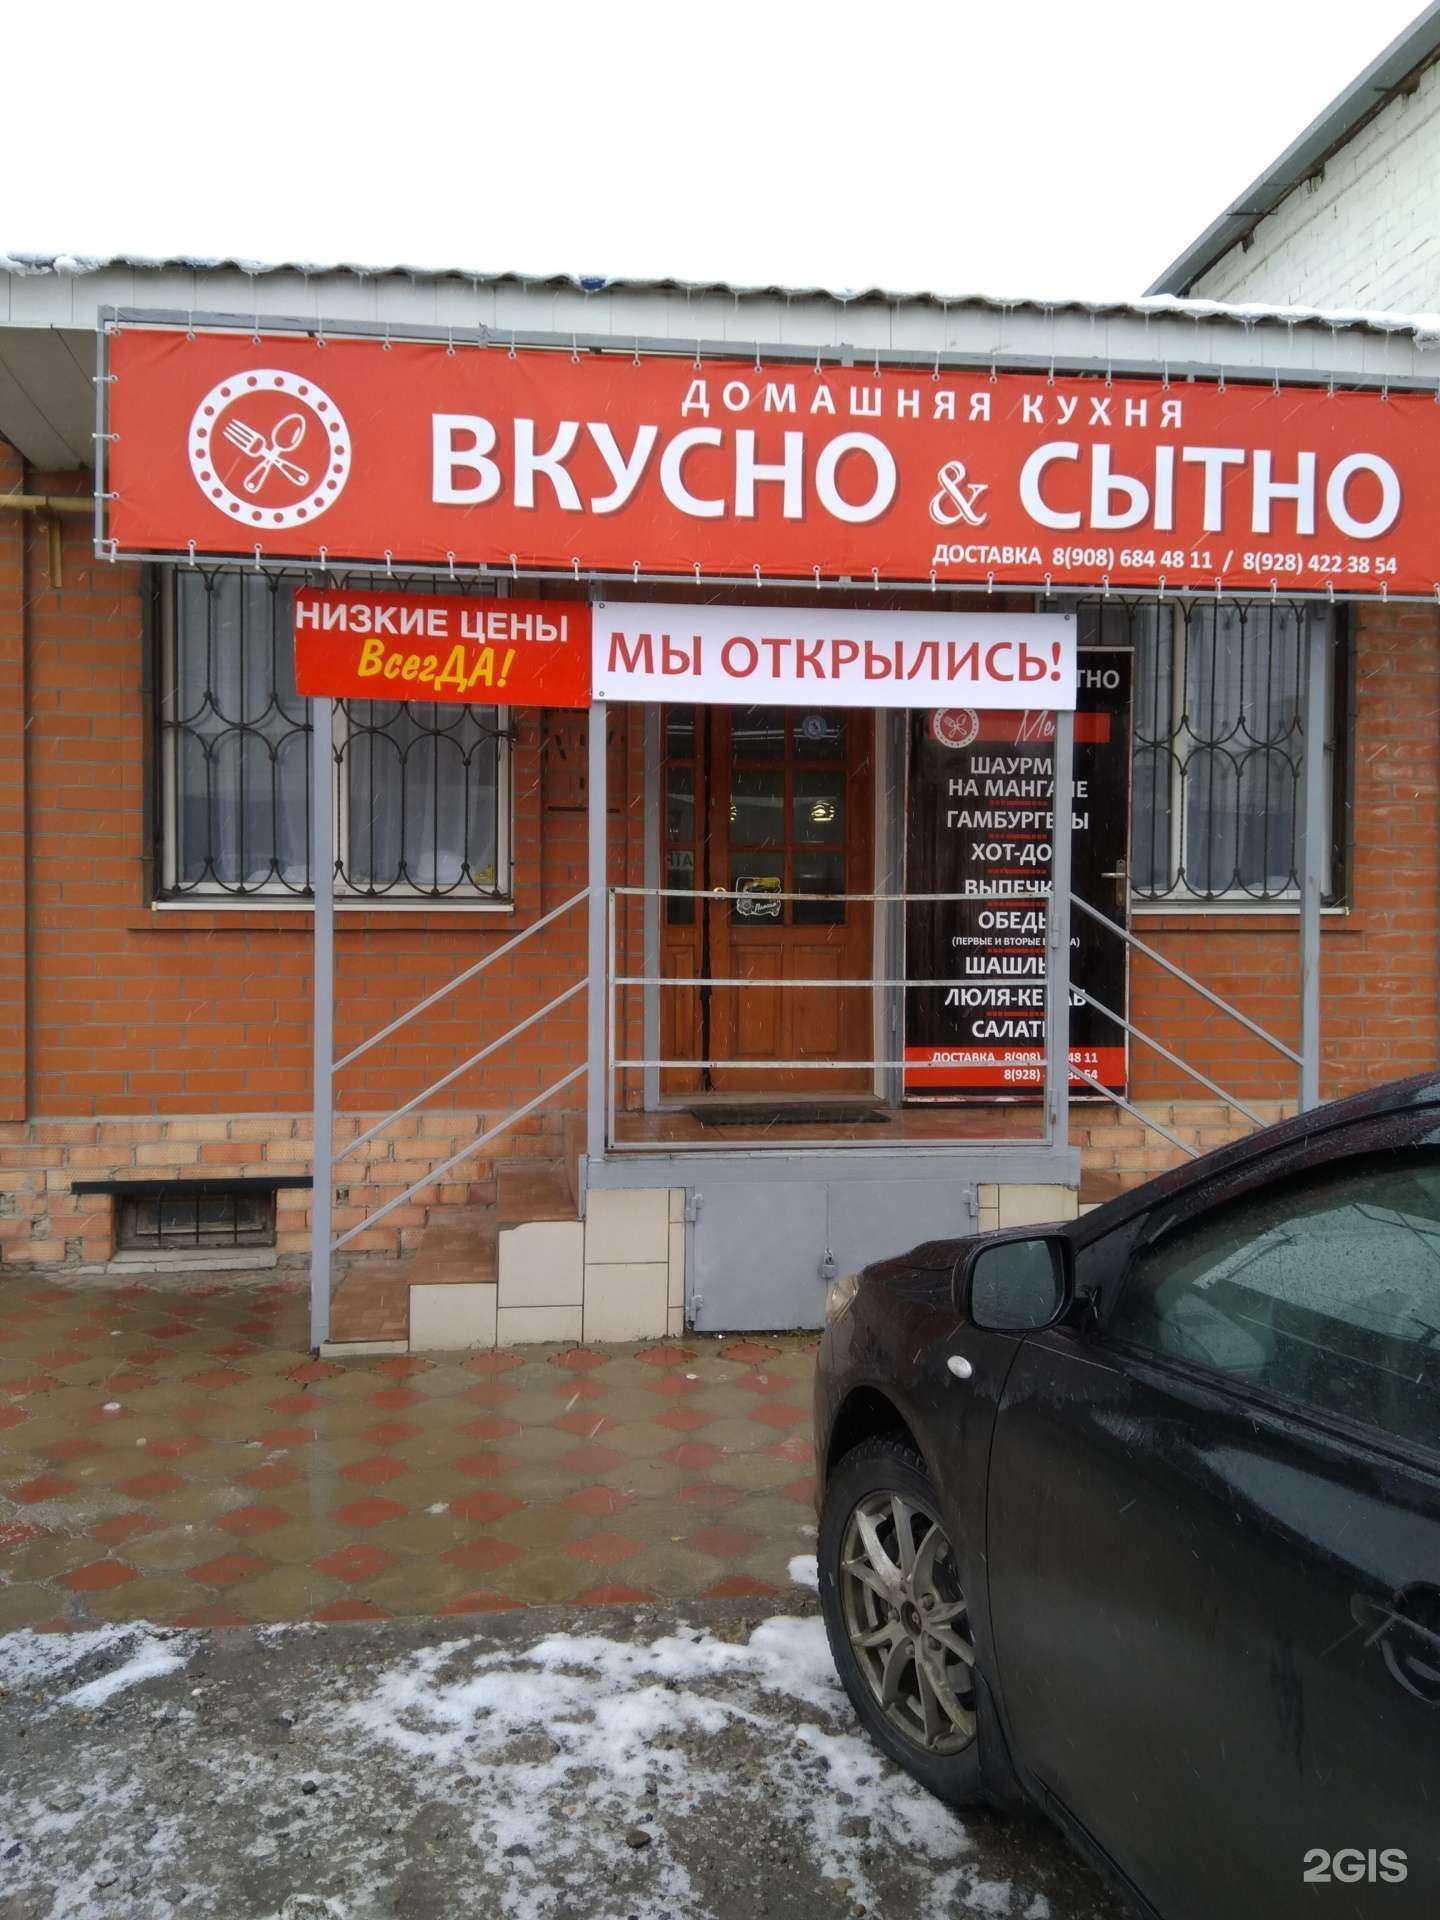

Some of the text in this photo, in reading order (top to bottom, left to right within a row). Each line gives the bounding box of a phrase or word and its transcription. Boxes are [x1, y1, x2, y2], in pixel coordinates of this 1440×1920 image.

[681, 379, 1182, 428] ДОМАШНЯЯ КУХНЯ
[431, 412, 1401, 539] ВКУСНО & СЫТНО
[932, 543, 1043, 566] ДОСТАВКА
[1052, 546, 1115, 571] 8(908)
[1119, 549, 1156, 568] 684
[1160, 550, 1185, 568] 48
[1190, 551, 1213, 569] 11
[1243, 551, 1303, 575] 8(928)
[1307, 554, 1343, 573] 422
[1347, 555, 1370, 574] 38
[1375, 556, 1398, 574] 54
[296, 602, 568, 643] НИЗКИЕ ЦЕНЫ
[607, 631, 1062, 682] МЫ ОТКРЫЛИСЬ!
[1077, 670, 1120, 689] ТНО
[970, 757, 1052, 775] ШАУРМ
[949, 780, 1088, 798] НА МАНГЕ
[947, 810, 1089, 830] ГАМБУРГЕЫ
[971, 843, 1052, 865] ХОТ-ДО
[965, 879, 1053, 895] ВЫПЕЧК
[952, 936, 992, 947] (ПЕРВЫЕ
[995, 937, 1002, 946] И
[1004, 937, 1040, 946] ВТОРЫЕ
[965, 957, 1046, 974] ШАШЛ
[972, 1020, 1045, 1038] САЛАТ
[931, 1052, 995, 1062] ДОСТАВКА
[1084, 1053, 1098, 1063] 11
[1003, 1069, 1041, 1081] 8(928)
